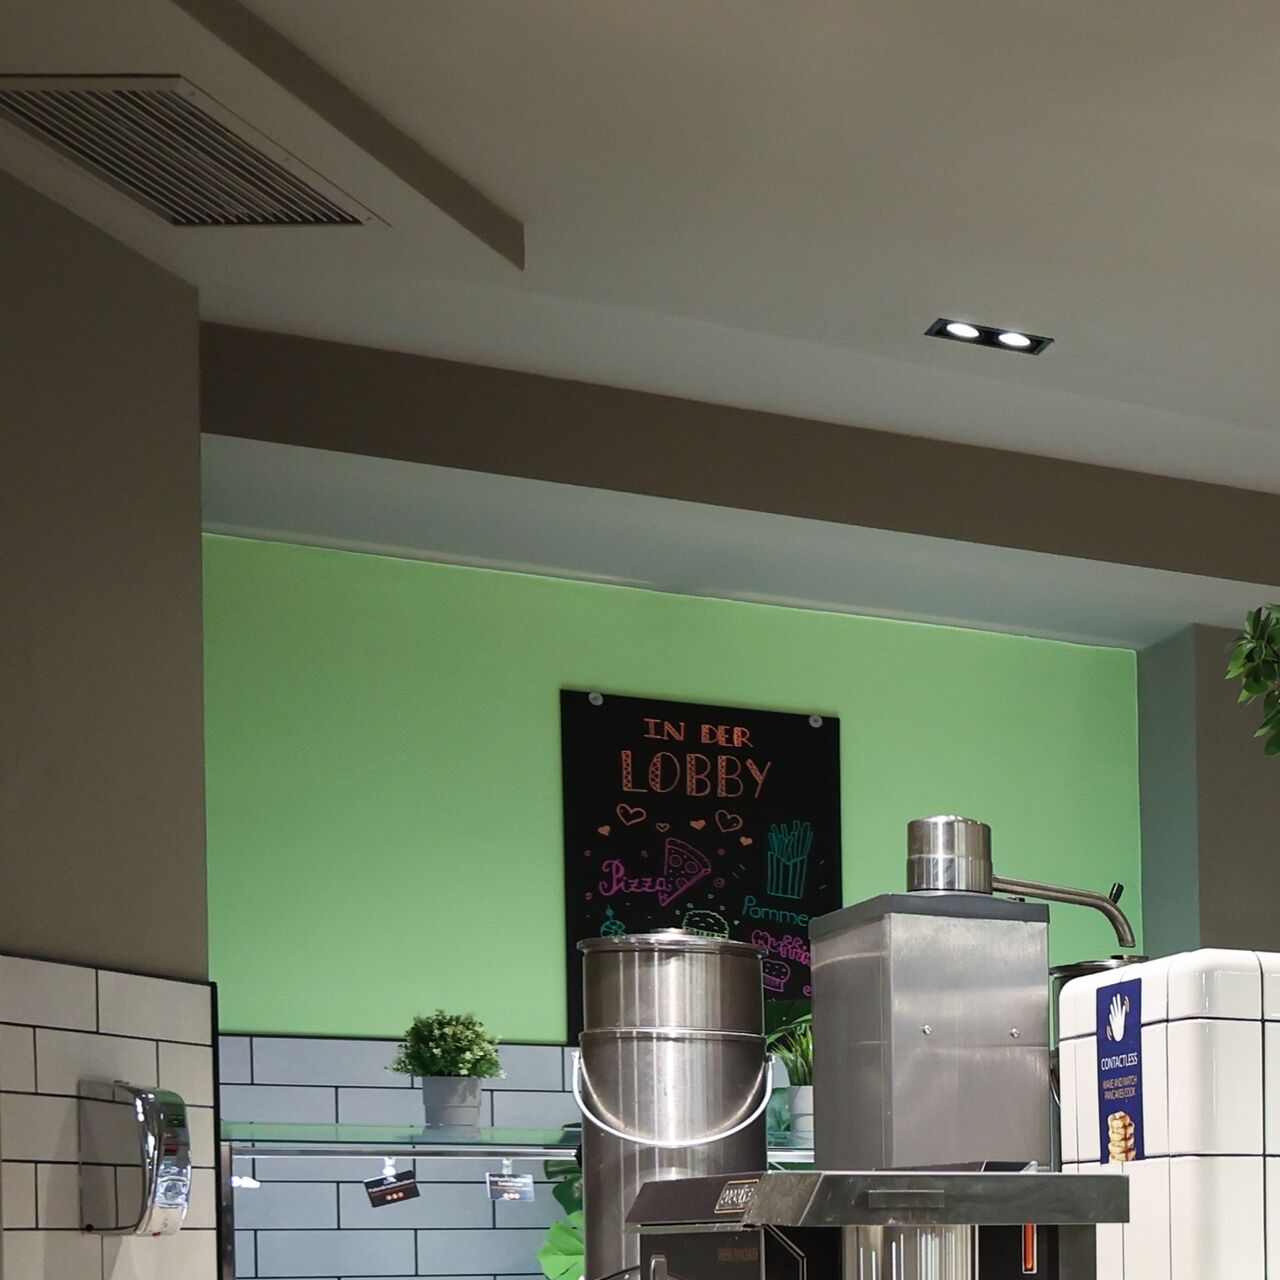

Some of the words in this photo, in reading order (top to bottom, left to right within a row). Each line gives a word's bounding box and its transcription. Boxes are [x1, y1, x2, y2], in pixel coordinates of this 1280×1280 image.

[644, 717, 685, 741] IN
[701, 723, 753, 748] DER
[621, 750, 772, 798] LOBBY
[599, 858, 672, 896] Pizza
[742, 895, 809, 927] Pomme
[752, 929, 811, 967] Muffi
[1101, 1052, 1138, 1071] CONTACTLESS
